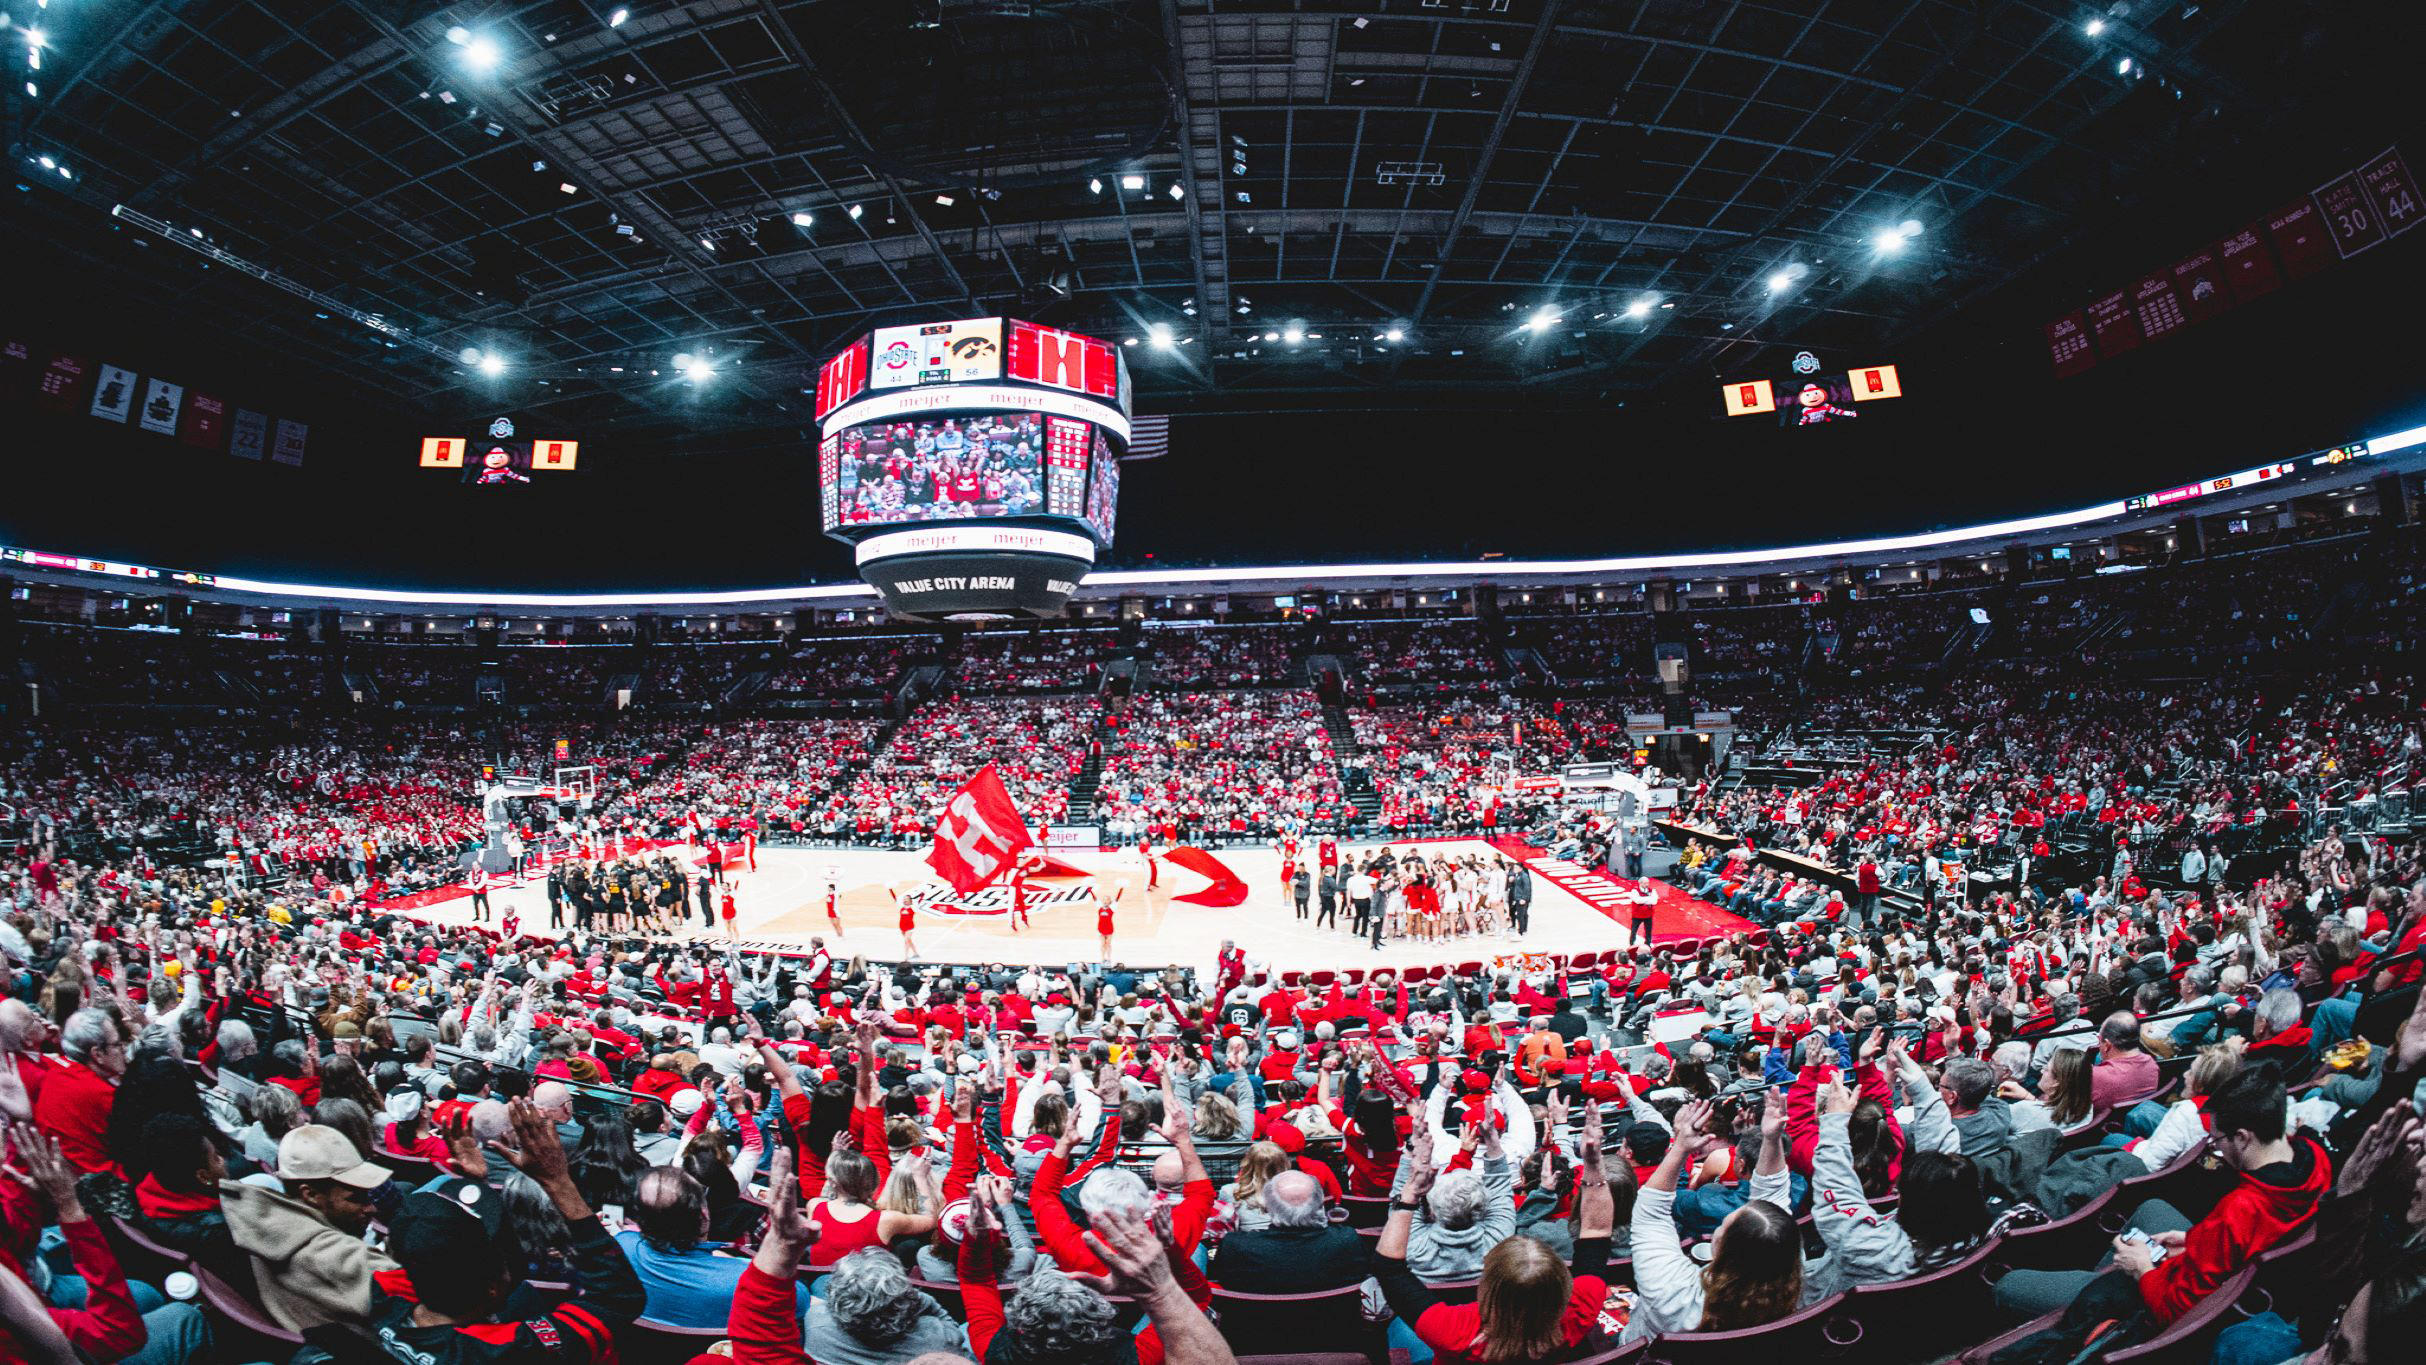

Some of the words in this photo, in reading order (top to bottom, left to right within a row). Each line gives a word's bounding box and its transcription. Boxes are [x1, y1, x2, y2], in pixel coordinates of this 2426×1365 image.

[2367, 160, 2399, 183] TRACEY
[2379, 177, 2401, 194] HALL
[2330, 196, 2358, 214] SMITH
[2389, 189, 2416, 220] 44
[2337, 208, 2369, 238] 30
[899, 393, 951, 409] meijer
[990, 393, 1044, 407] meijer
[907, 535, 957, 549] meijer
[993, 534, 1044, 548] meijer
[894, 579, 933, 594] VALUE
[934, 577, 967, 590] CITY
[969, 577, 1016, 590] ARENA
